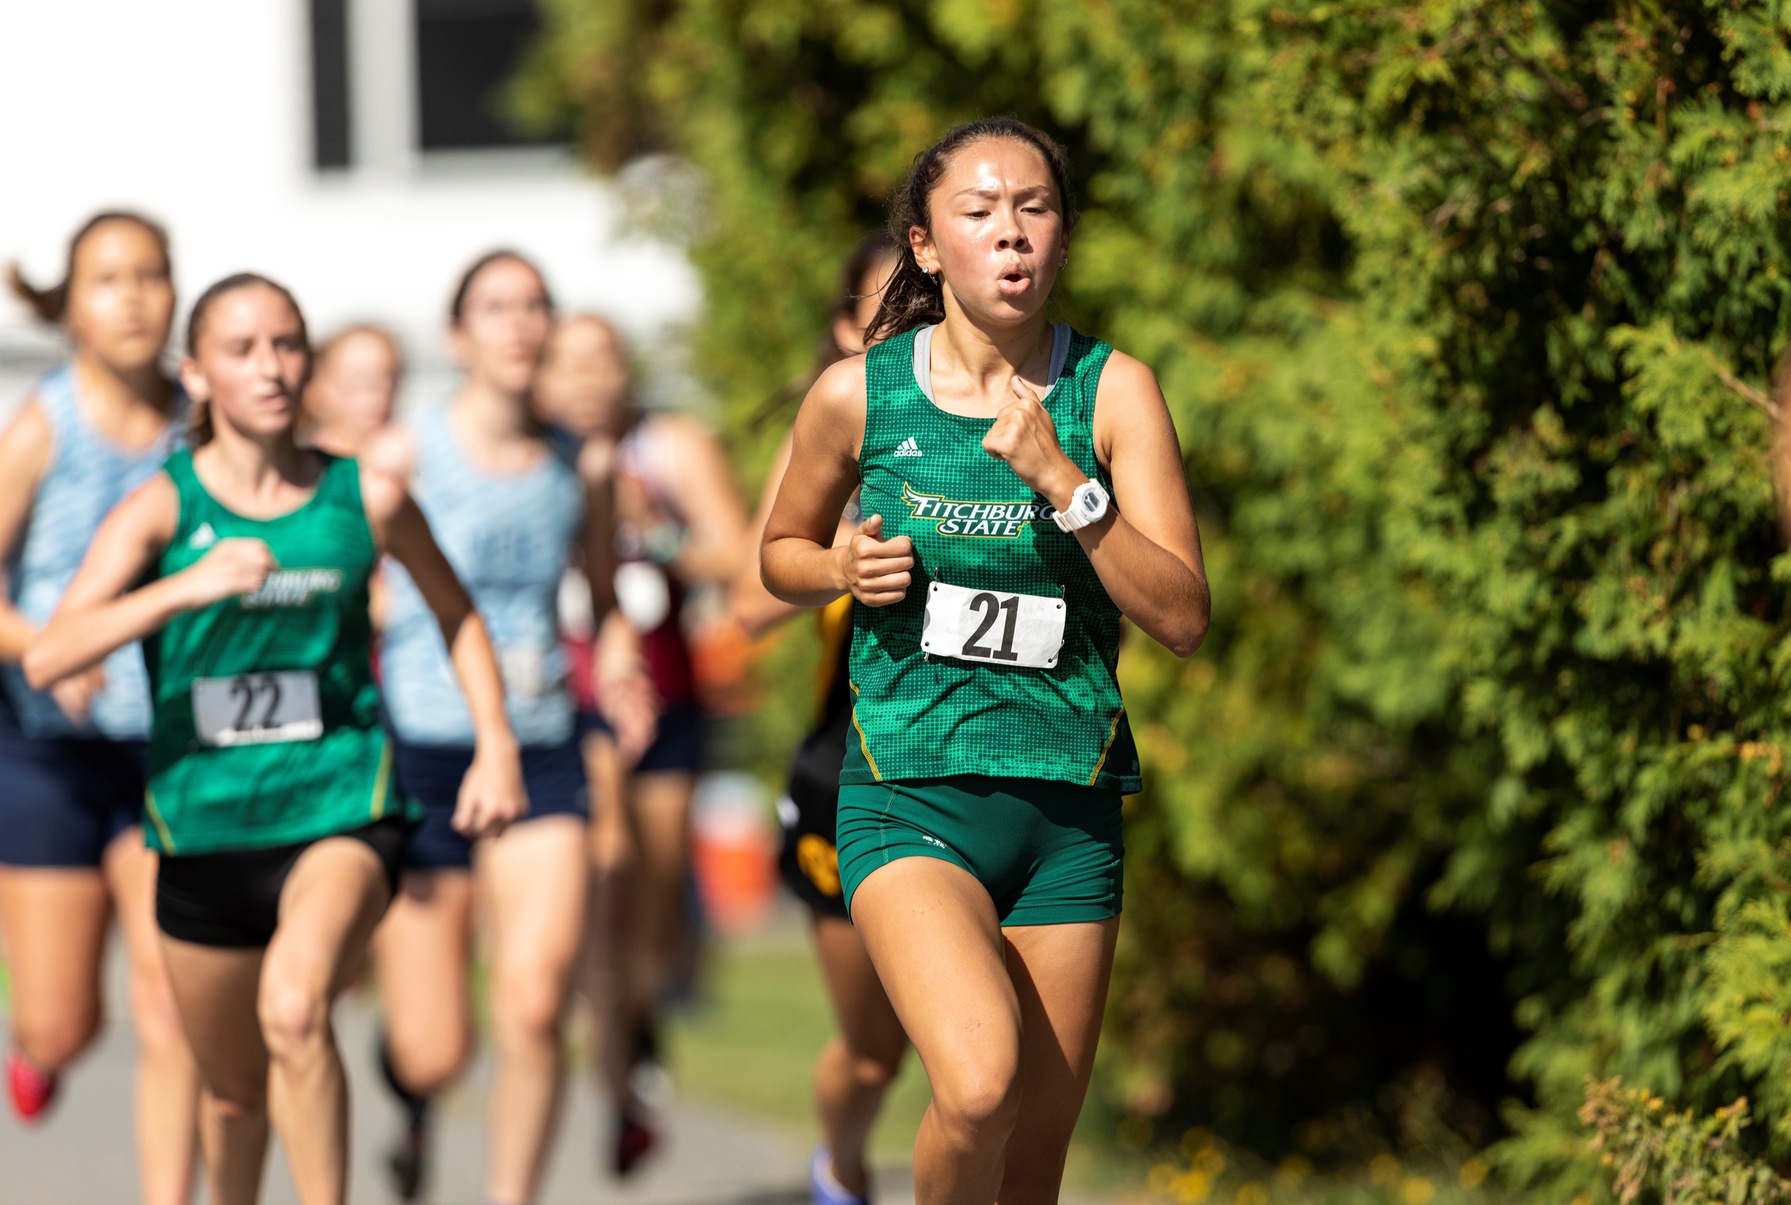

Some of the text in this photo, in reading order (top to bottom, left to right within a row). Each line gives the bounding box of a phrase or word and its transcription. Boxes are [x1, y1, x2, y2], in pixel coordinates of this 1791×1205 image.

[893, 448, 923, 457] adidas
[903, 488, 1056, 520] FITCHBURG
[939, 519, 1021, 536] STATE
[962, 592, 1020, 662] 21
[230, 674, 283, 731] 22
